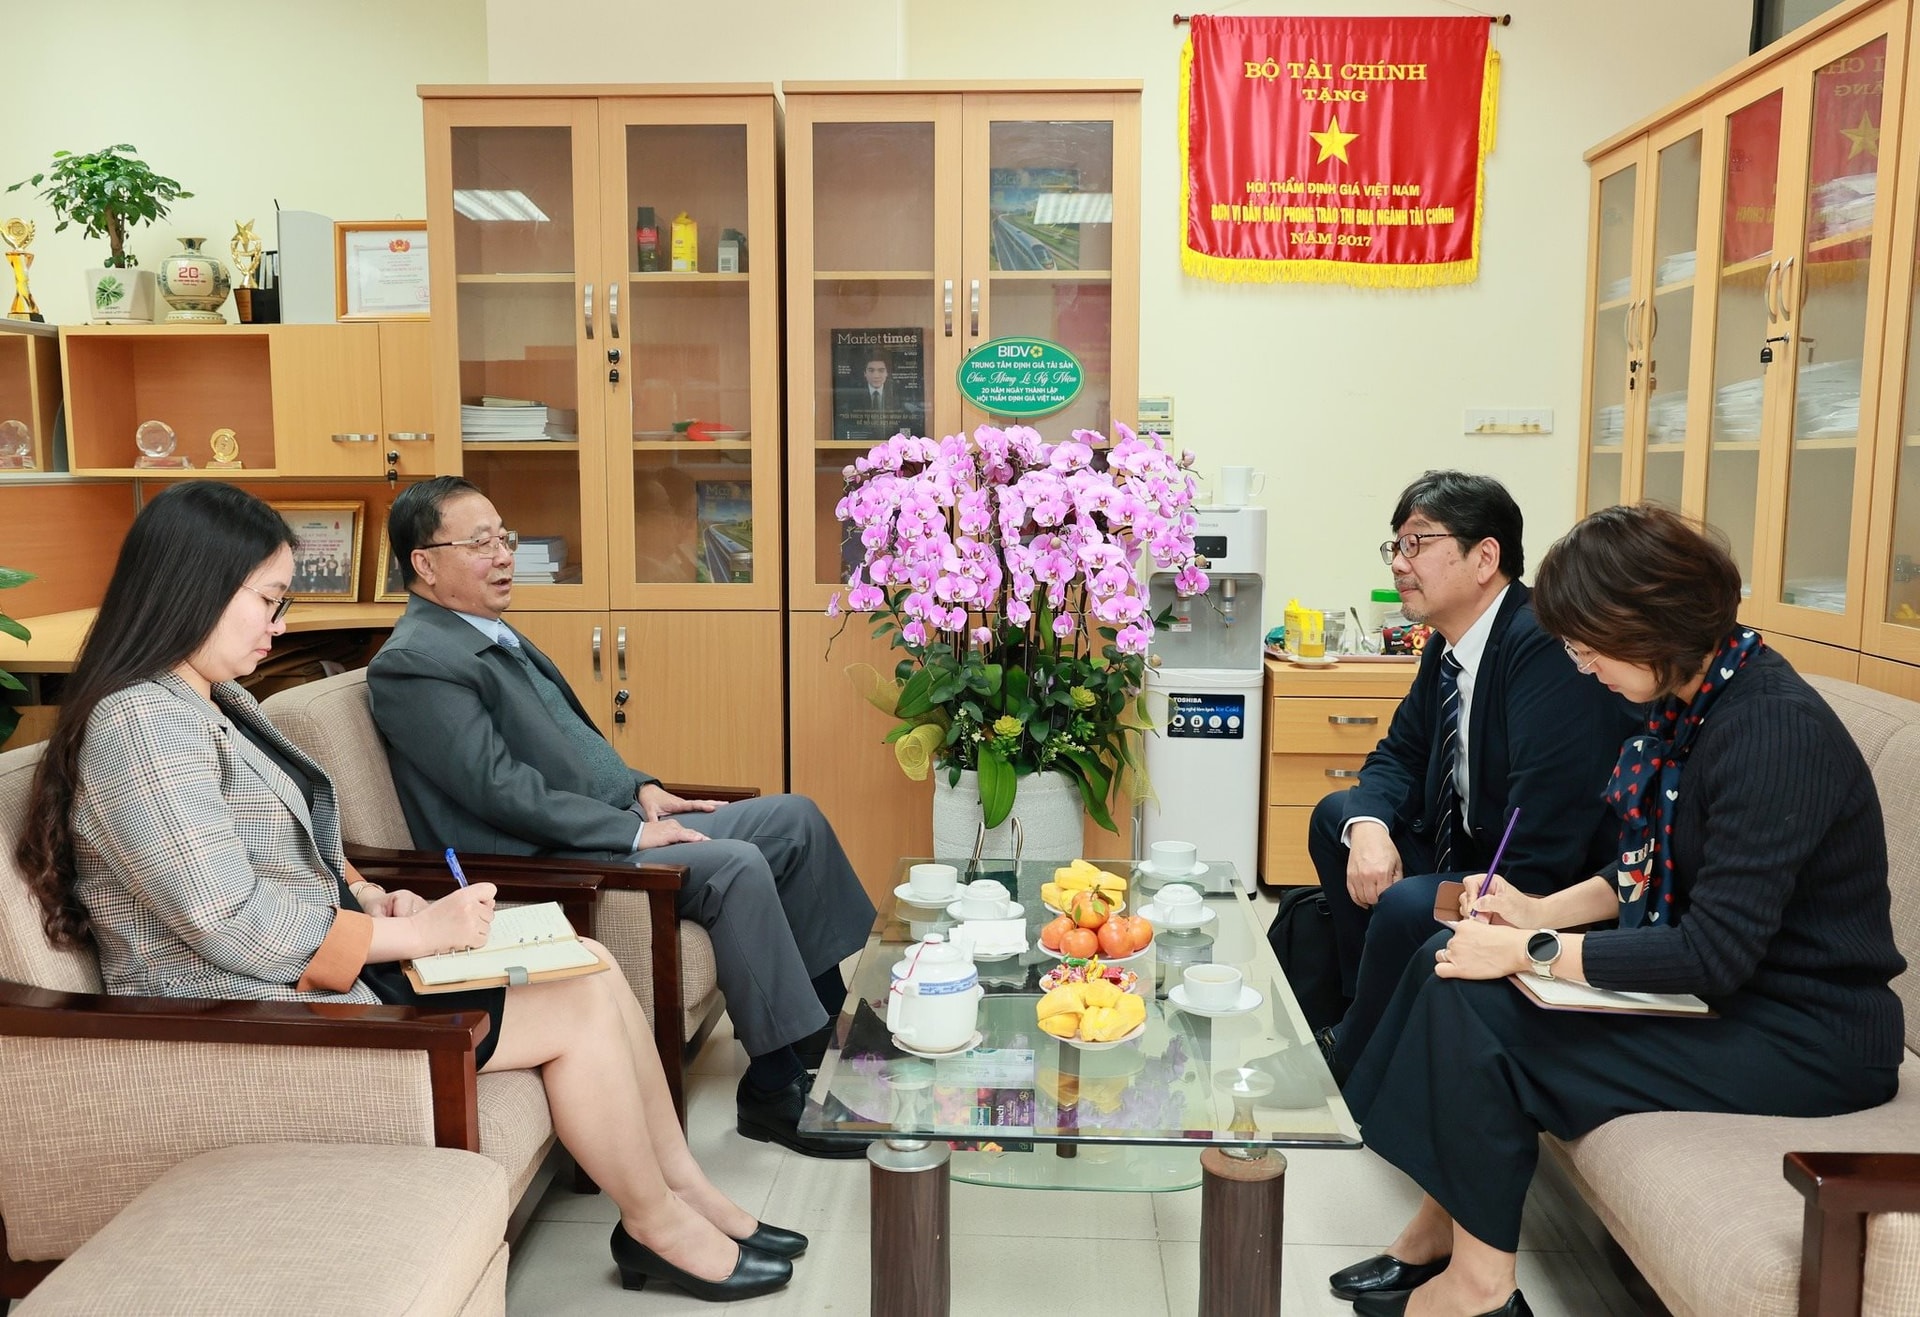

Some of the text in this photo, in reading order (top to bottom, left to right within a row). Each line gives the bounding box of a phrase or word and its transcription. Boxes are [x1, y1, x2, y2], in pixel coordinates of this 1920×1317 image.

[1244, 57, 1427, 82] BỘ TÀI CHÍNH
[1302, 87, 1368, 103] TẶNG
[1246, 177, 1420, 199] HỘI THẨM ĐỊNH GIÁ VIỆT NAM
[1283, 206, 1315, 223] PHONG
[1340, 207, 1355, 224] THI
[1376, 205, 1408, 226] NGÀNH
[1409, 206, 1424, 226] TÀI
[1425, 203, 1455, 225] CHÍNH
[1290, 229, 1373, 247] NĂM 2017
[838, 332, 917, 345] Market times
[998, 345, 1031, 357] BIDV
[971, 361, 995, 369] TRUNG
[996, 360, 1012, 369] TÂM
[1013, 361, 1031, 370] ĐỊNH
[1032, 360, 1045, 369] GIÁ
[1047, 360, 1057, 369] TÀI
[990, 386, 1005, 394] NĂM
[1005, 386, 1023, 394] NGÀY
